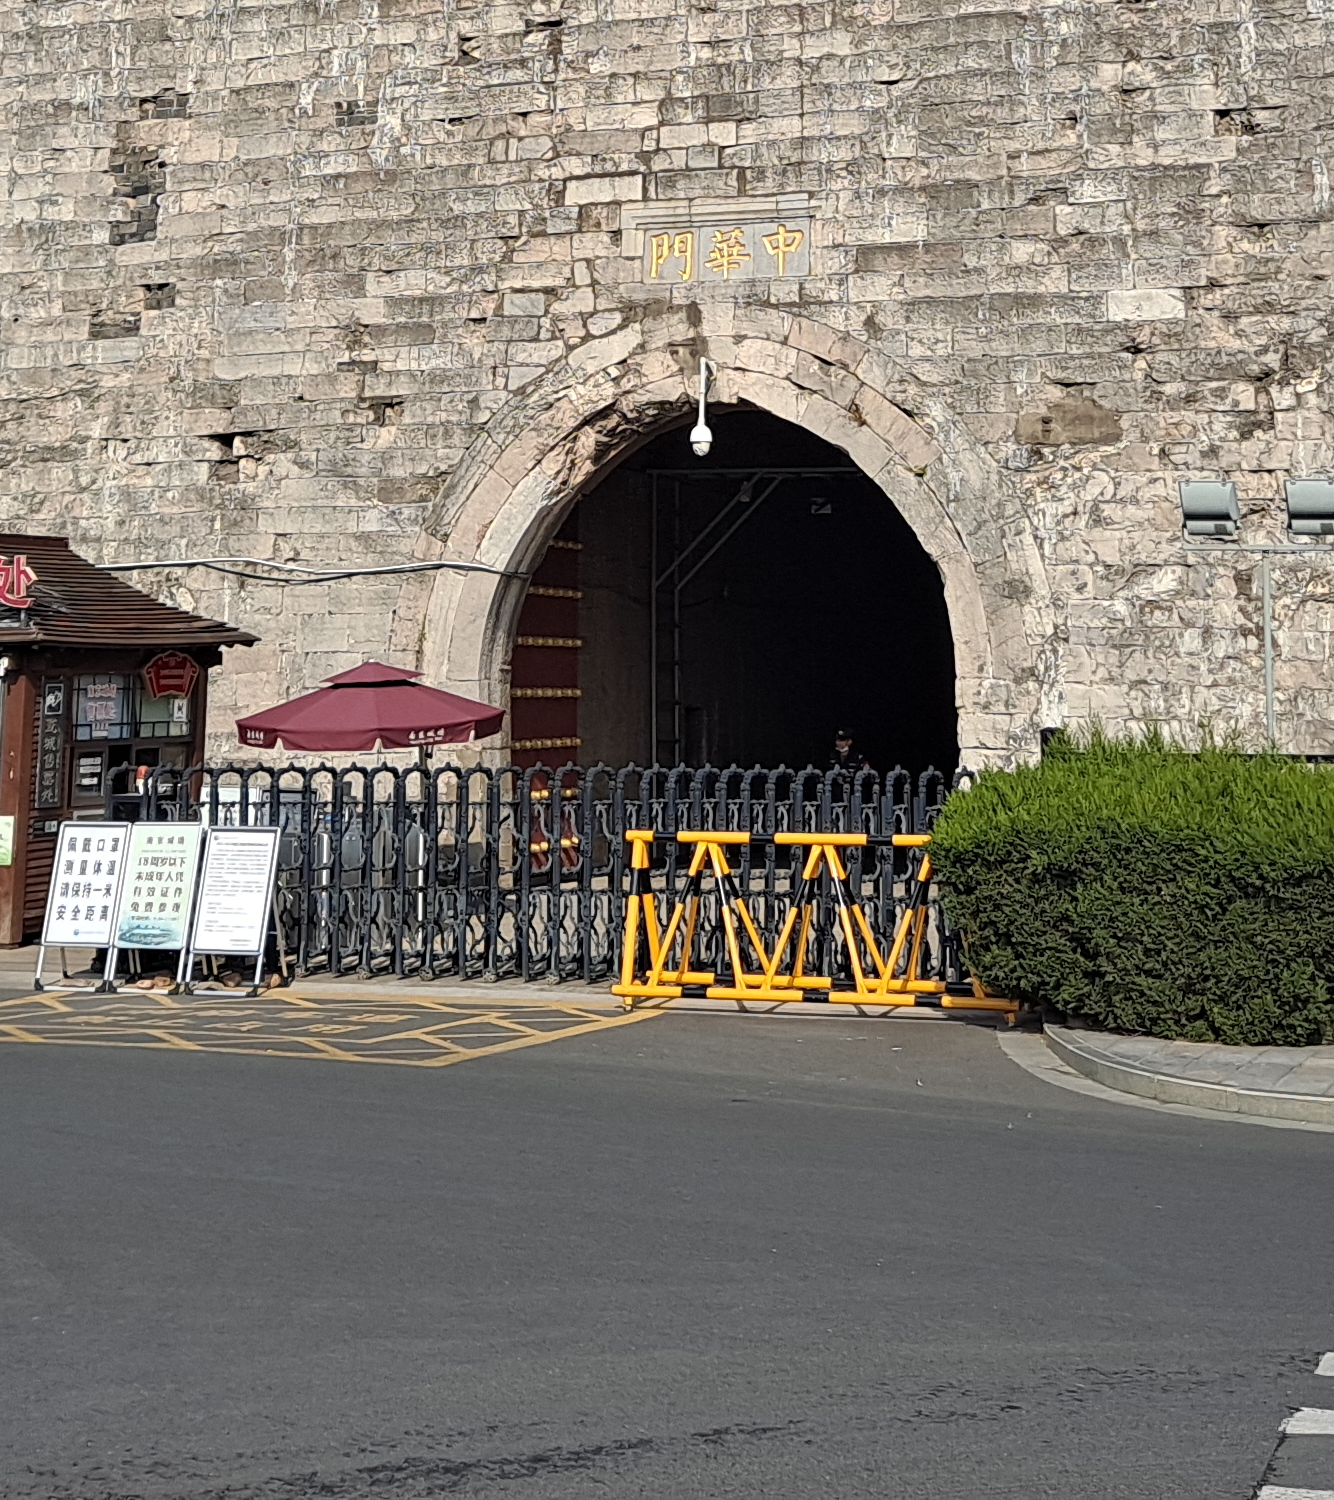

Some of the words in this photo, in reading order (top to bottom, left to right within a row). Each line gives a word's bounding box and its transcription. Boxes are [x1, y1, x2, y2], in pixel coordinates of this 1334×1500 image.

[649, 223, 805, 282] 中華門
[67, 836, 120, 853] 佩戴口罩
[63, 859, 117, 876] 测量体温
[59, 882, 113, 899] 请保持一米
[55, 904, 110, 921] 安全距离
